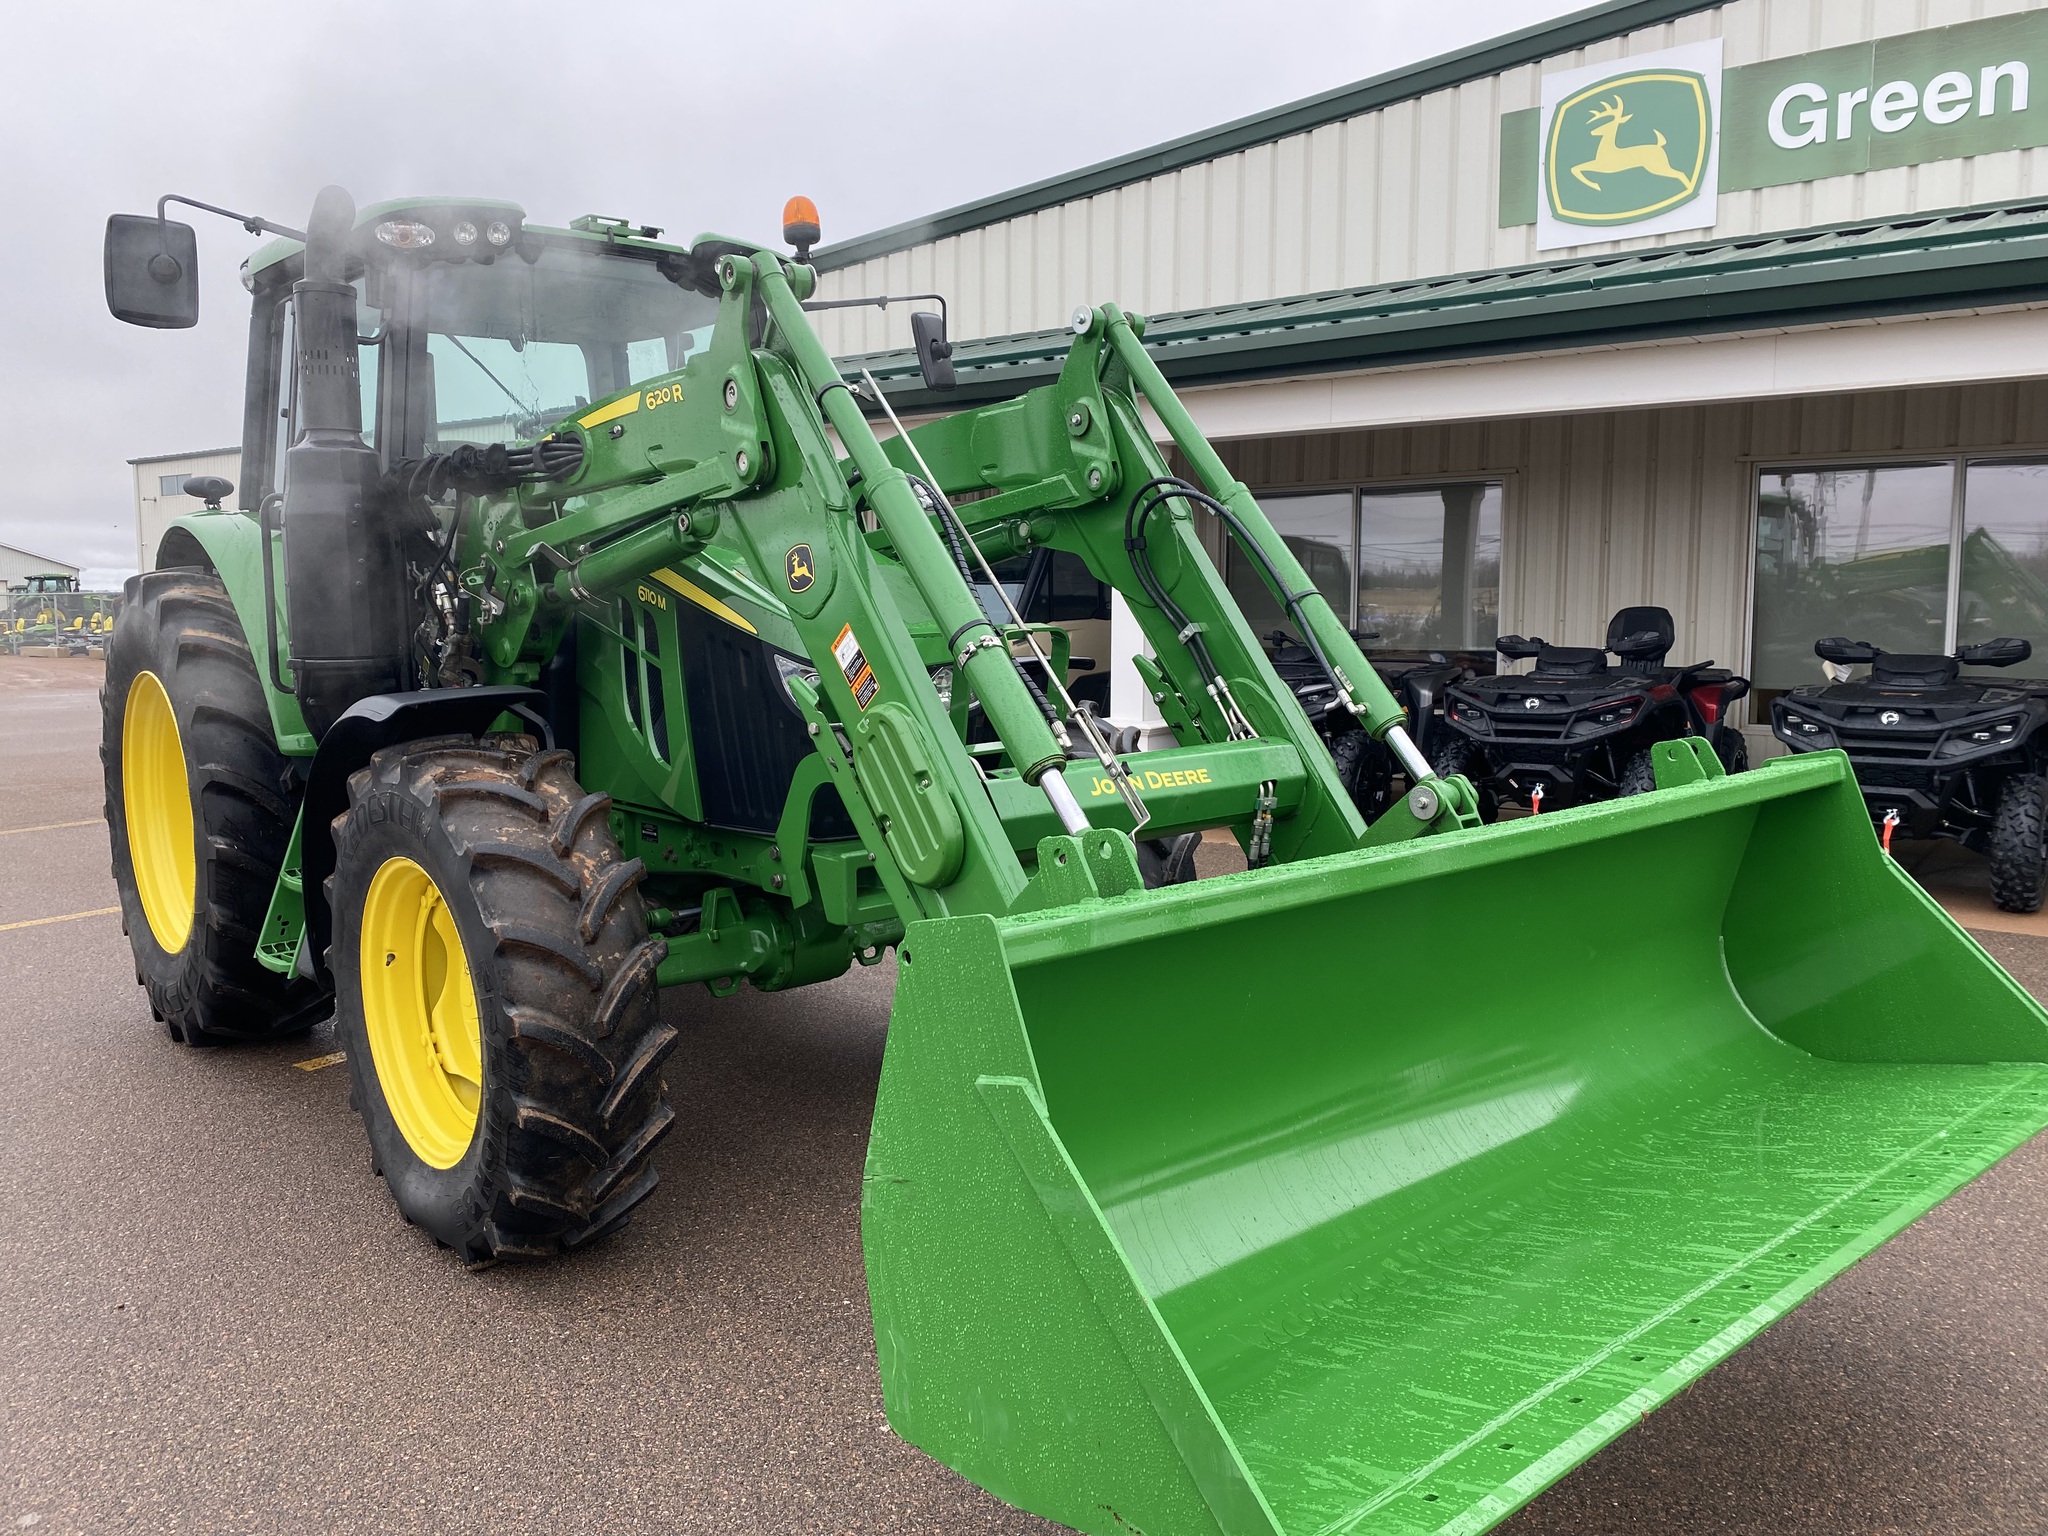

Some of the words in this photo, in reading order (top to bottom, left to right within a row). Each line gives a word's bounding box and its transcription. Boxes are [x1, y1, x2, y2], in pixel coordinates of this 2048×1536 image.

[1767, 61, 2030, 149] Green
[645, 386, 671, 410] 620
[671, 383, 685, 404] R
[637, 584, 657, 606] 6110
[657, 593, 667, 611] M
[1144, 768, 1213, 790] DEERE
